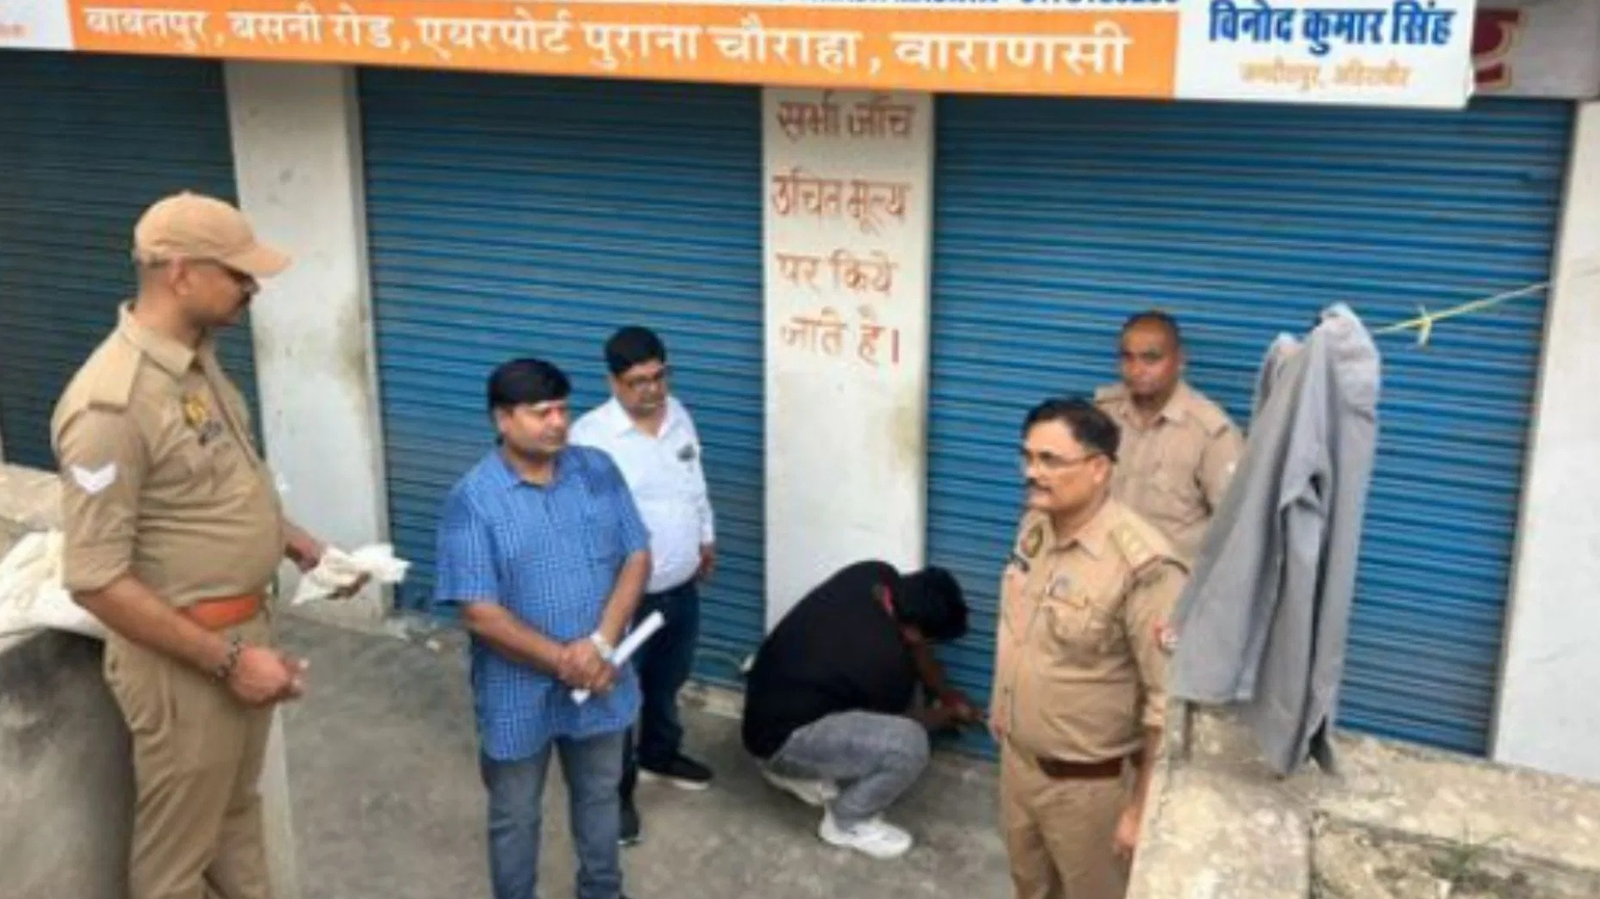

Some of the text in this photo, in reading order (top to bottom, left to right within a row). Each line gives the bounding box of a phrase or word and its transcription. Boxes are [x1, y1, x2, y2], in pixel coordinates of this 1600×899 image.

[227, 3, 323, 45] बसनी
[415, 6, 573, 60] एयरपोर्ट
[581, 21, 703, 70] पुराना
[890, 20, 1133, 75] वाराणसी
[1209, 0, 1457, 55] विनोद कुमार सिंह
[773, 166, 913, 228] उचित मूल्य
[775, 249, 898, 296] पर किये
